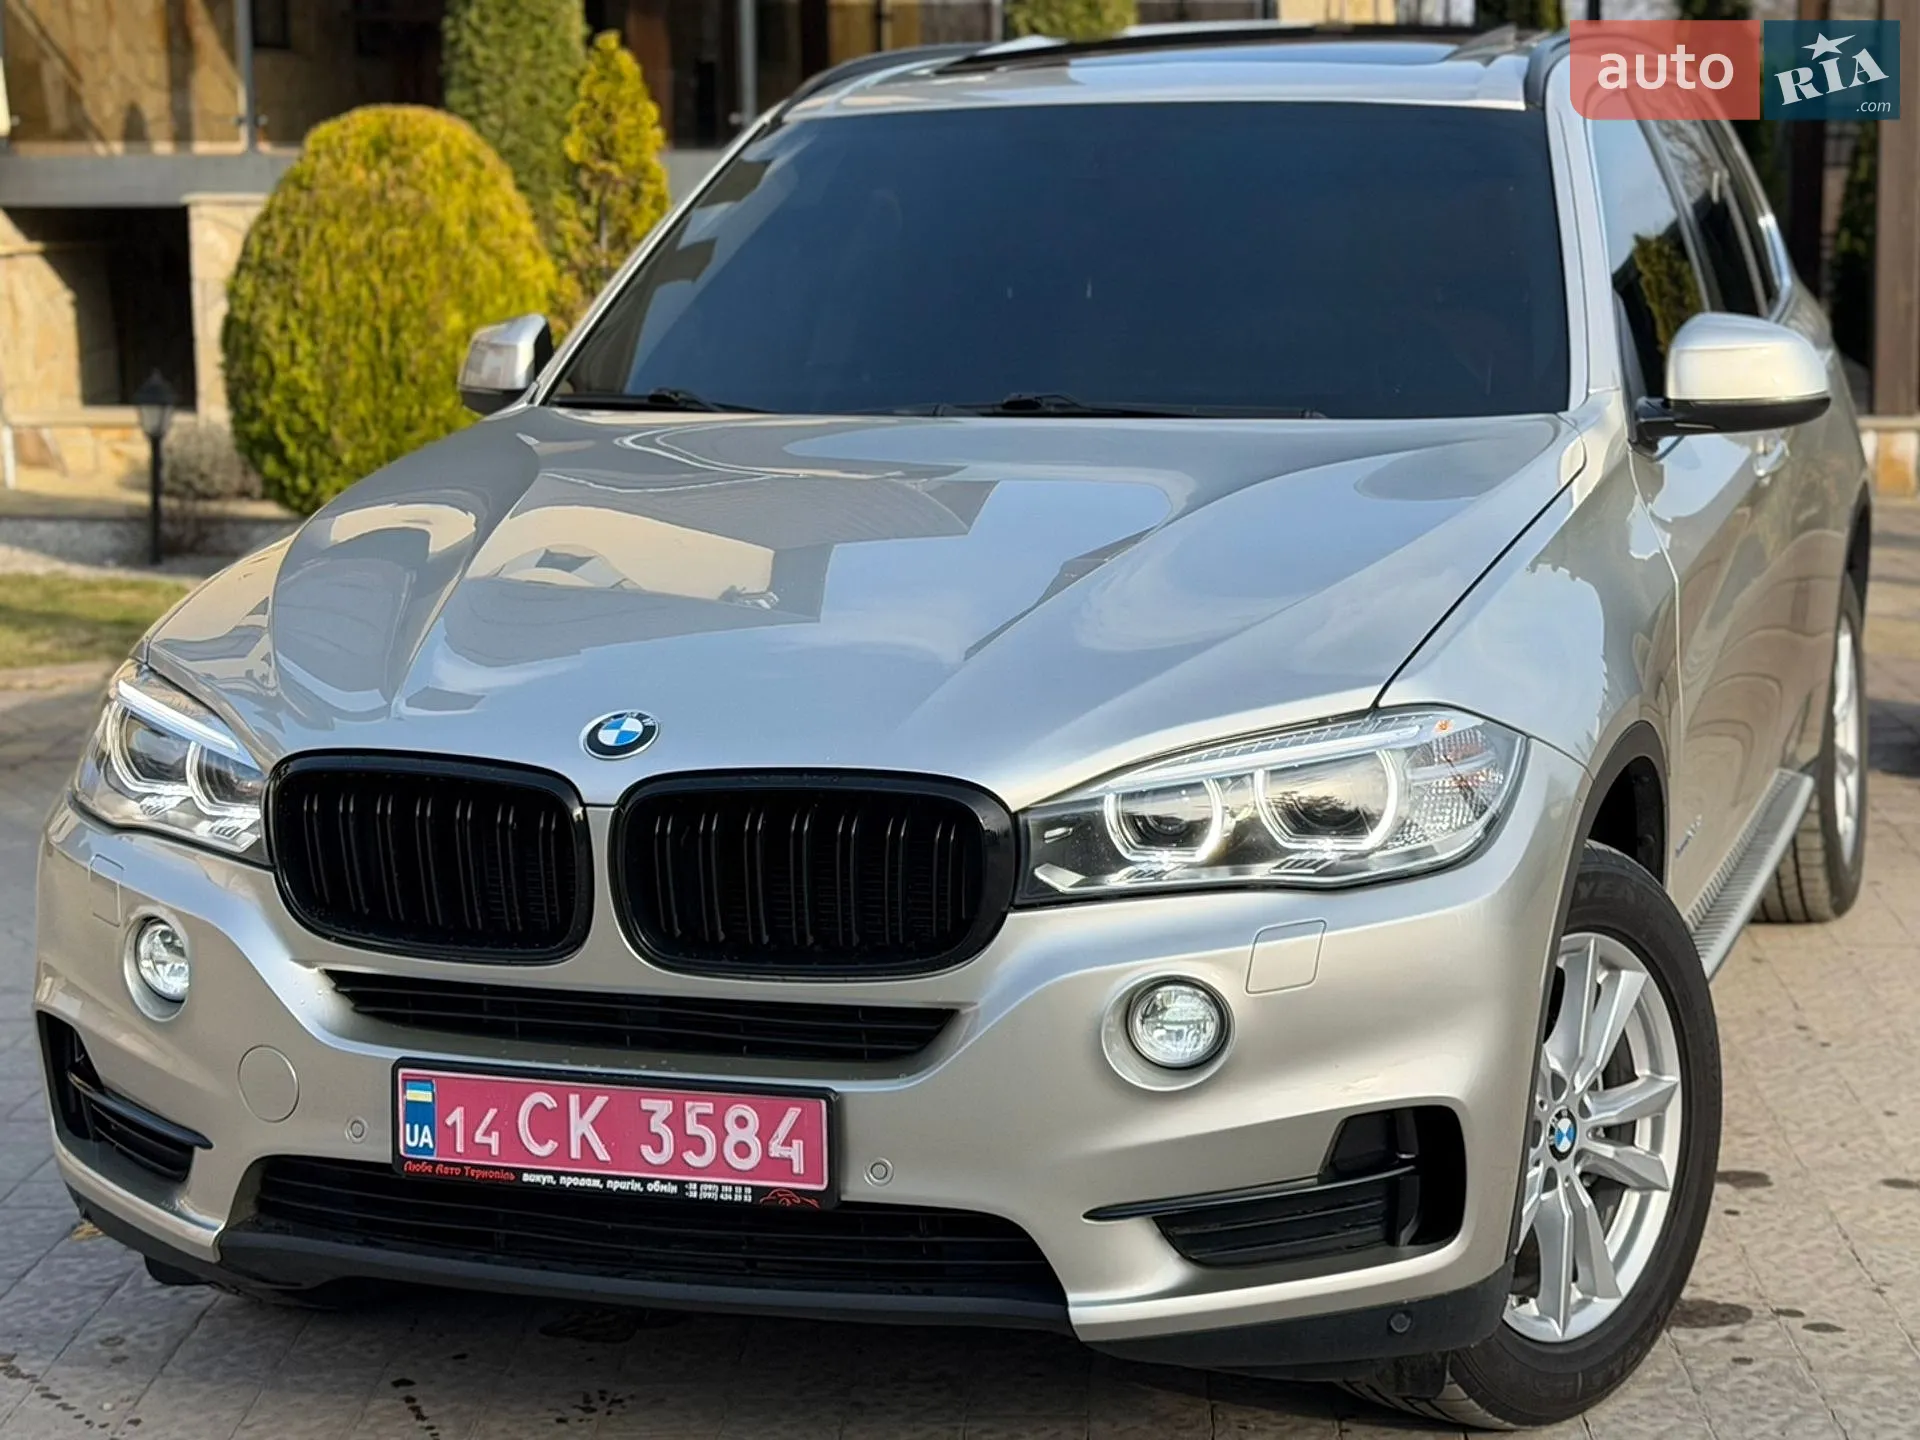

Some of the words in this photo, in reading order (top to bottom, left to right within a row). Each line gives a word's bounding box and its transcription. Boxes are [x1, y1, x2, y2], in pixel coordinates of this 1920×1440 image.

[405, 1123, 434, 1149] UA
[445, 1106, 499, 1157] 14
[517, 1091, 612, 1162] CK
[640, 1098, 804, 1175] 3584
